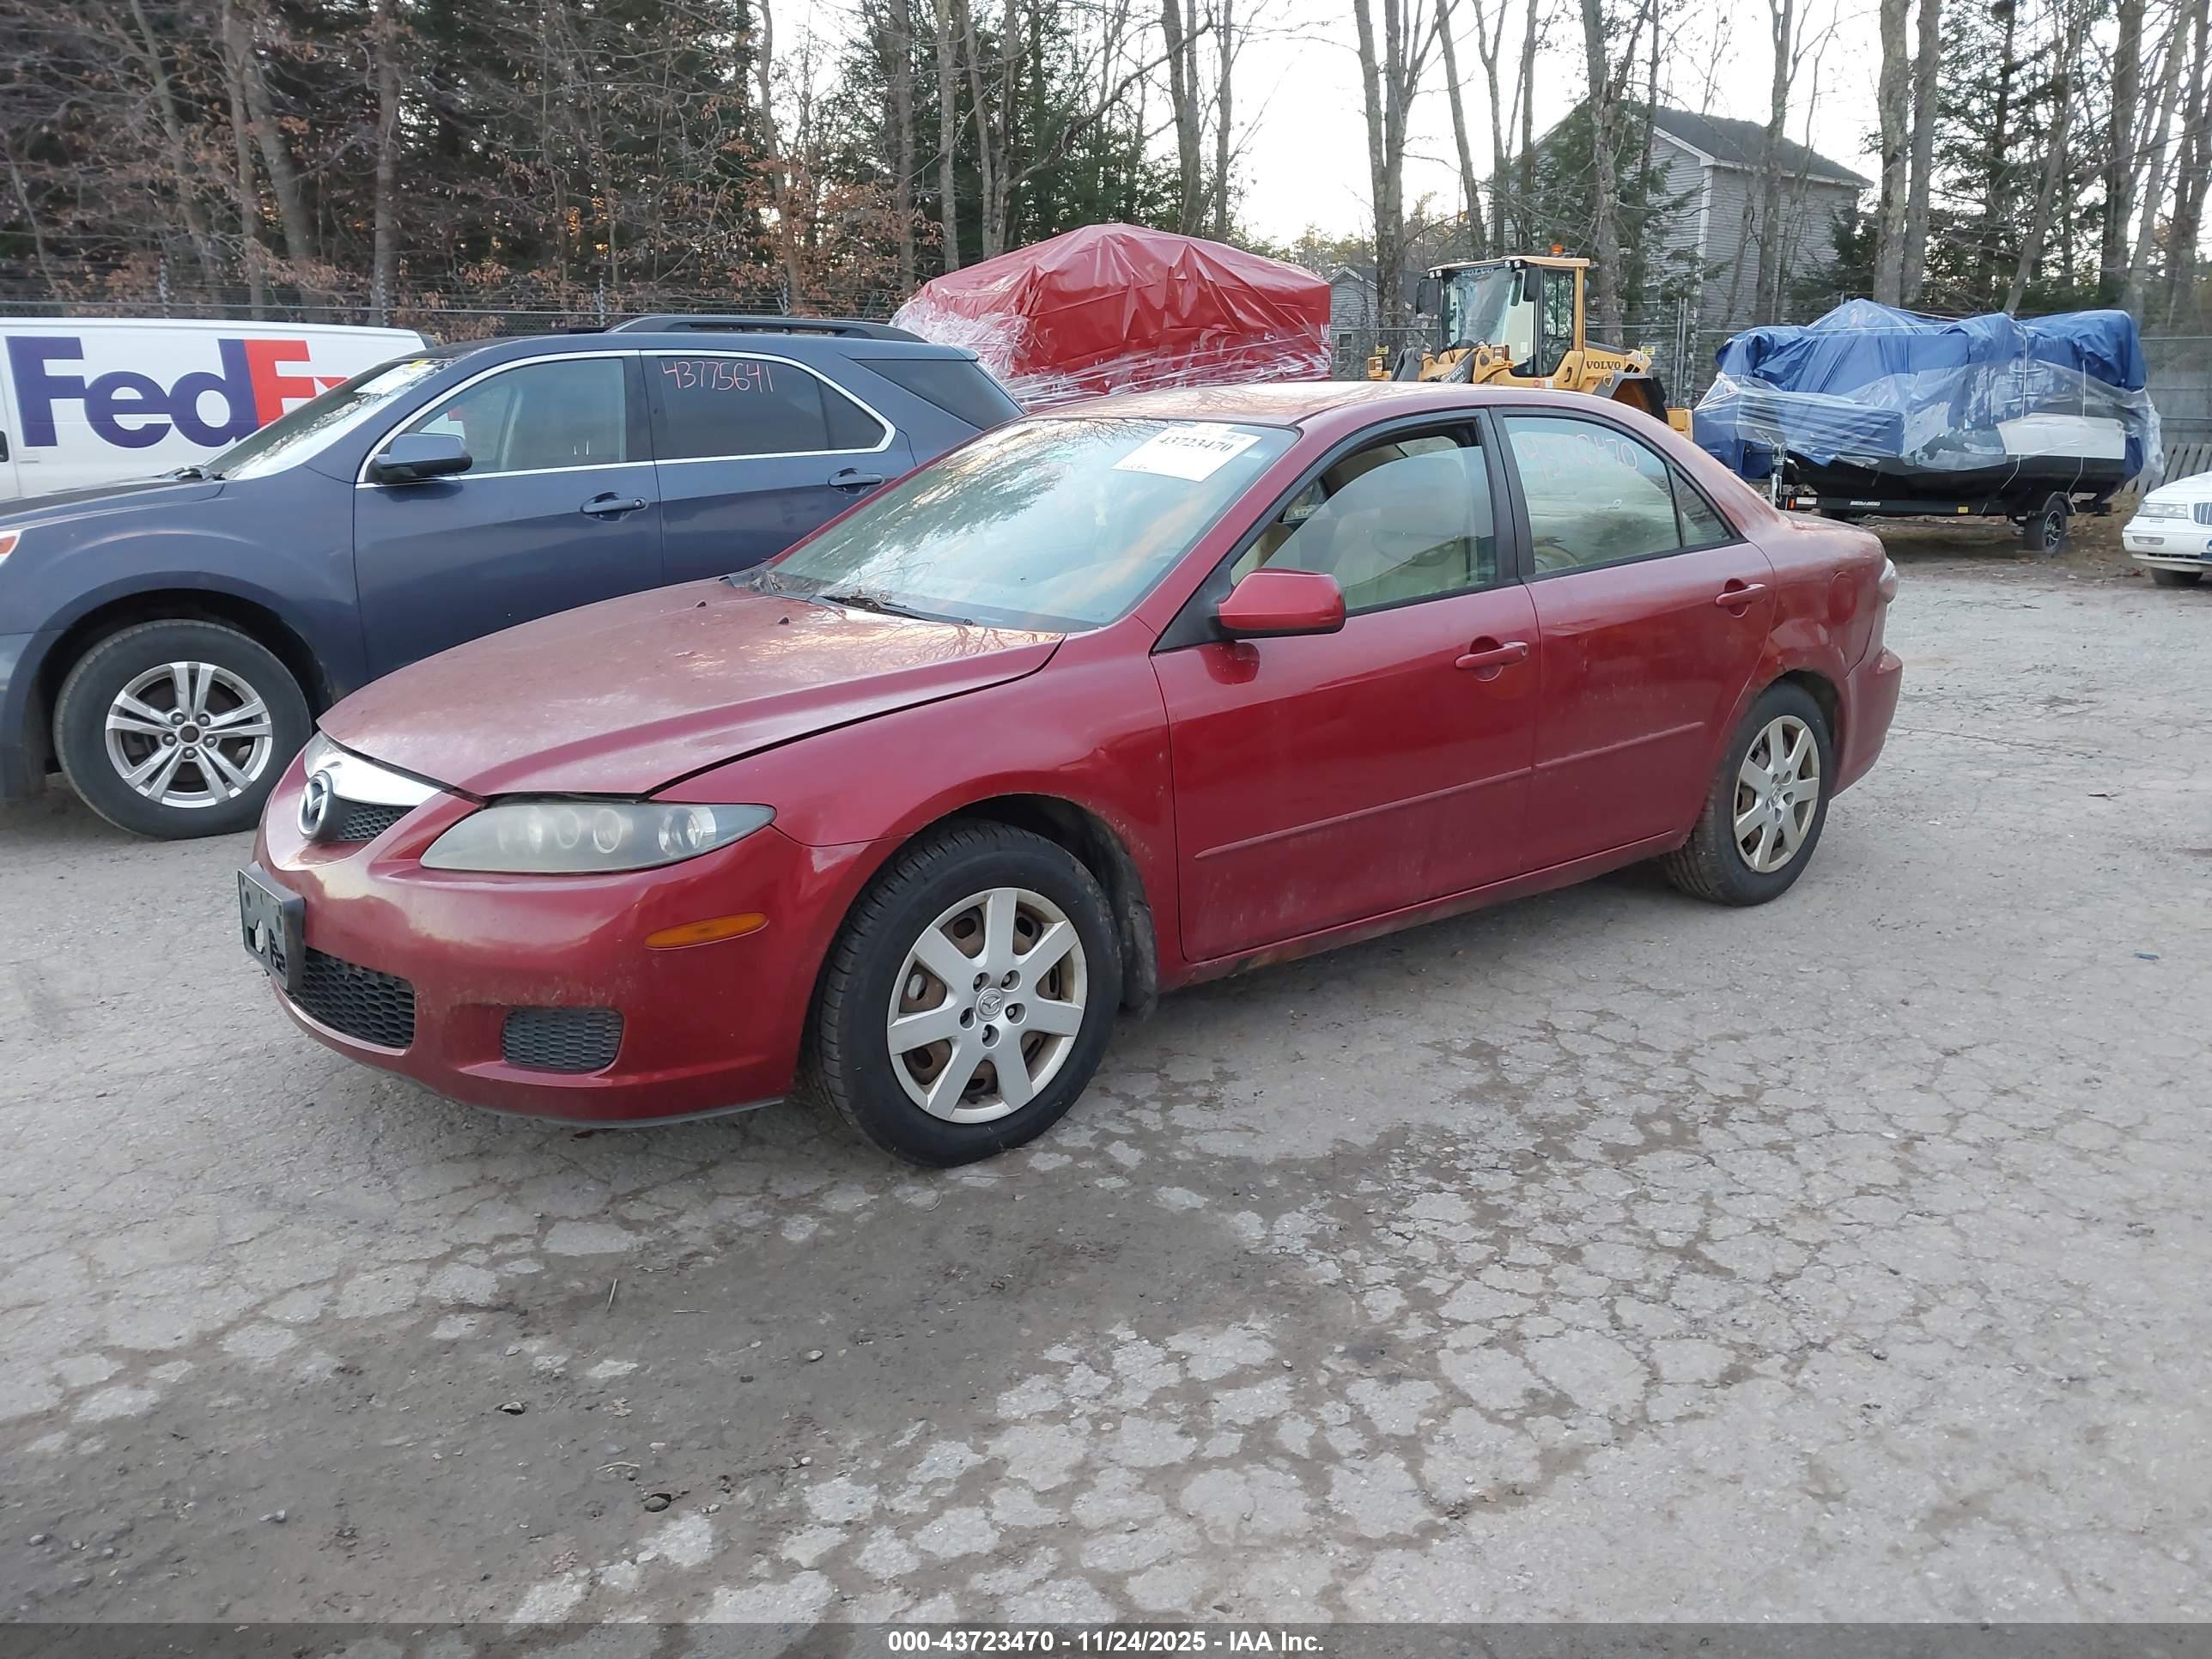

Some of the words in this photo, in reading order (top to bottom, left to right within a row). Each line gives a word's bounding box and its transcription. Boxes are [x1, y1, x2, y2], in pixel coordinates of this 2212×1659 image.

[660, 361, 773, 393] 43775641
[1586, 361, 1621, 369] VOLVO
[5, 336, 348, 448] FedE
[1519, 434, 1638, 478] 43470
